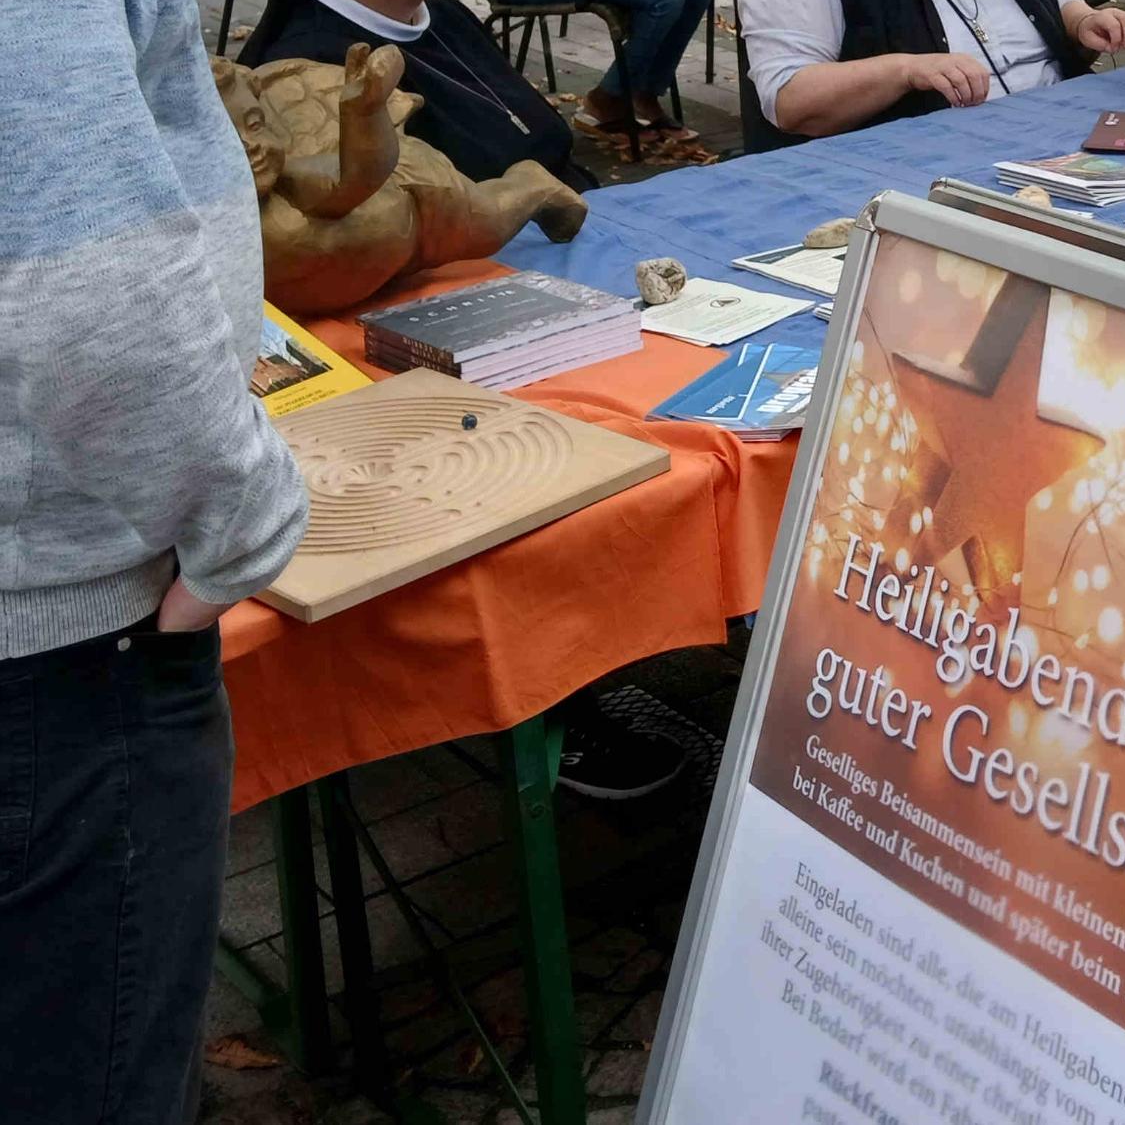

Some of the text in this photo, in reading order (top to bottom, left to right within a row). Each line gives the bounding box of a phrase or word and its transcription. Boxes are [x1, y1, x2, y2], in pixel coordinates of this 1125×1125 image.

[806, 646, 933, 753] guter
[805, 734, 878, 798] Geselliges
[879, 780, 1011, 881] Beisammensein
[1014, 868, 1051, 904] mit
[793, 765, 817, 801] bei
[816, 782, 865, 832] Kaffee
[865, 821, 899, 855] und
[898, 836, 966, 899] Kuchen
[967, 885, 1008, 924] und
[1009, 907, 1071, 961] später
[1071, 939, 1122, 996] beim
[795, 862, 875, 937] Eingeladen
[878, 925, 915, 963] sind
[760, 920, 794, 963] ihrer
[778, 895, 824, 945] alleine
[824, 933, 858, 970] sein
[781, 978, 806, 1017] Bei
